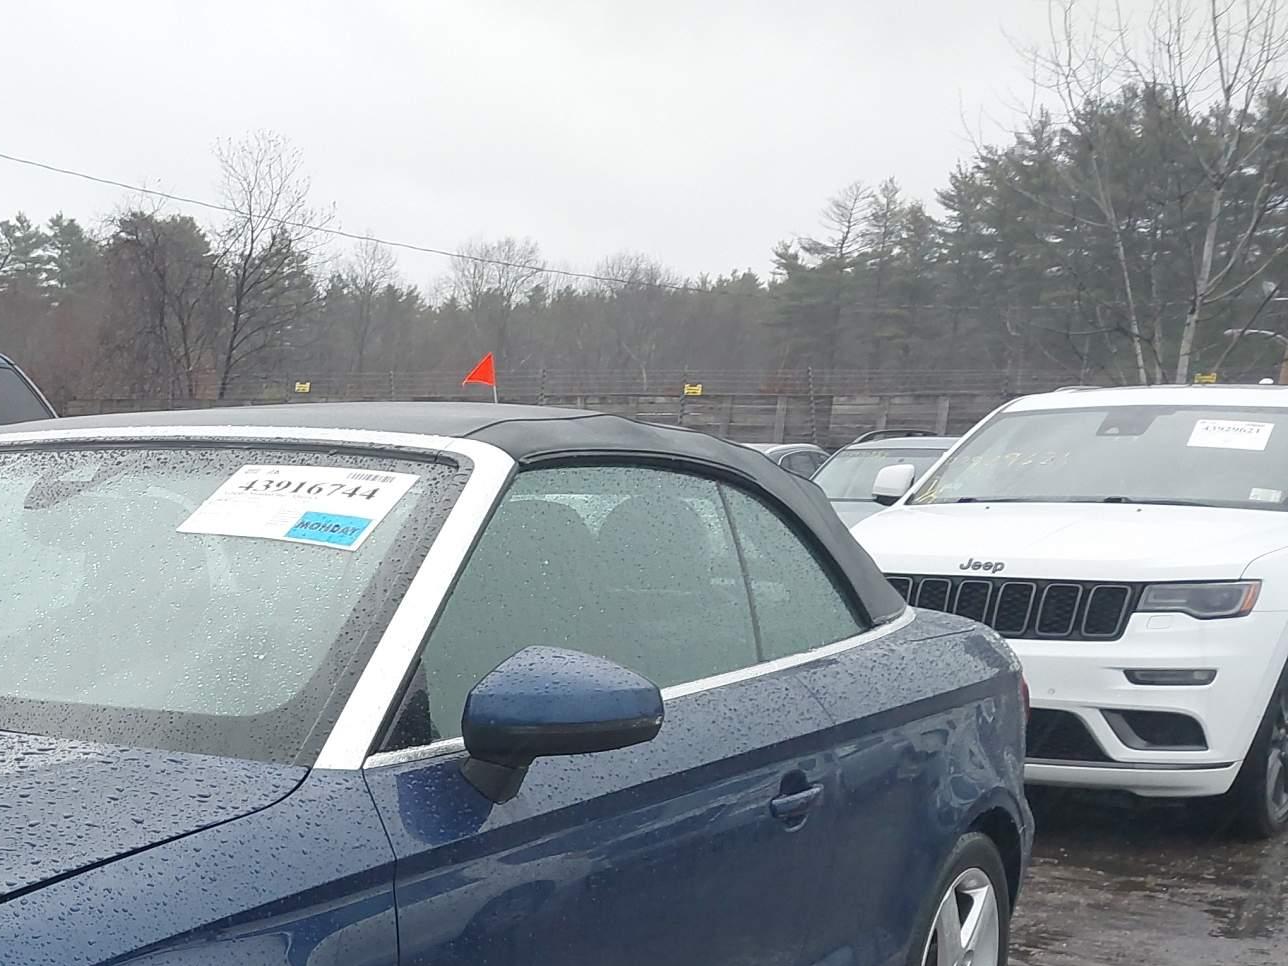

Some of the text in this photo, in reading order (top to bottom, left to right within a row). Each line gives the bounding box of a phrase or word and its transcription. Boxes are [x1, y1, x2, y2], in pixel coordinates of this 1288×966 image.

[238, 478, 381, 500] 43916744
[295, 519, 362, 536] MONDAY
[959, 557, 1006, 574] Jeep
